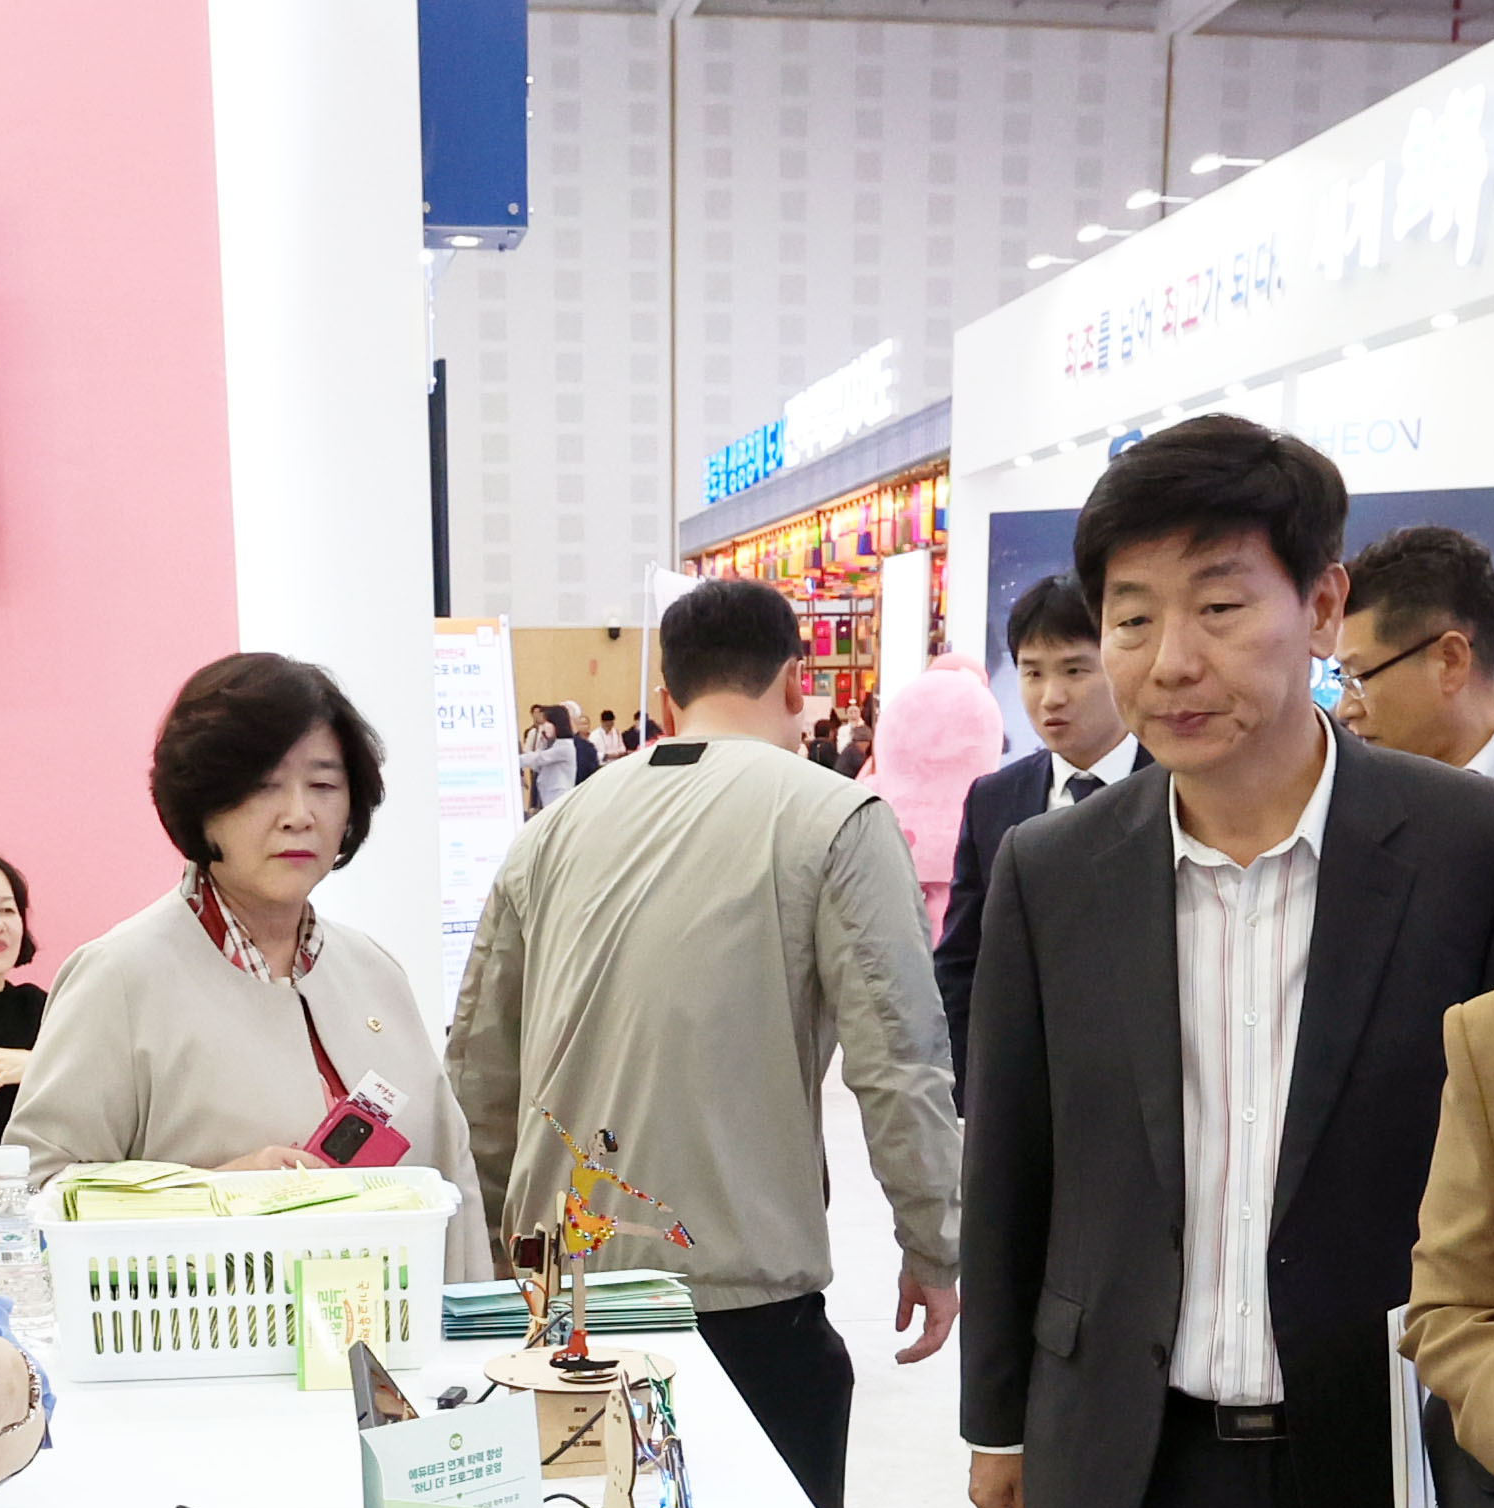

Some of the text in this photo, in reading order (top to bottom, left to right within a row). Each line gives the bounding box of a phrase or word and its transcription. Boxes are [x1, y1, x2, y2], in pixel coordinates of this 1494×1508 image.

[1064, 310, 1111, 378] 최초를
[1120, 289, 1153, 360] 넘어
[1162, 257, 1222, 342] 최고가
[408, 1462, 445, 1480] 에듀테크
[447, 1457, 465, 1471] 연계
[486, 1446, 503, 1461] 향상
[449, 1467, 483, 1486] 프로그램
[485, 1461, 502, 1476] 운영
